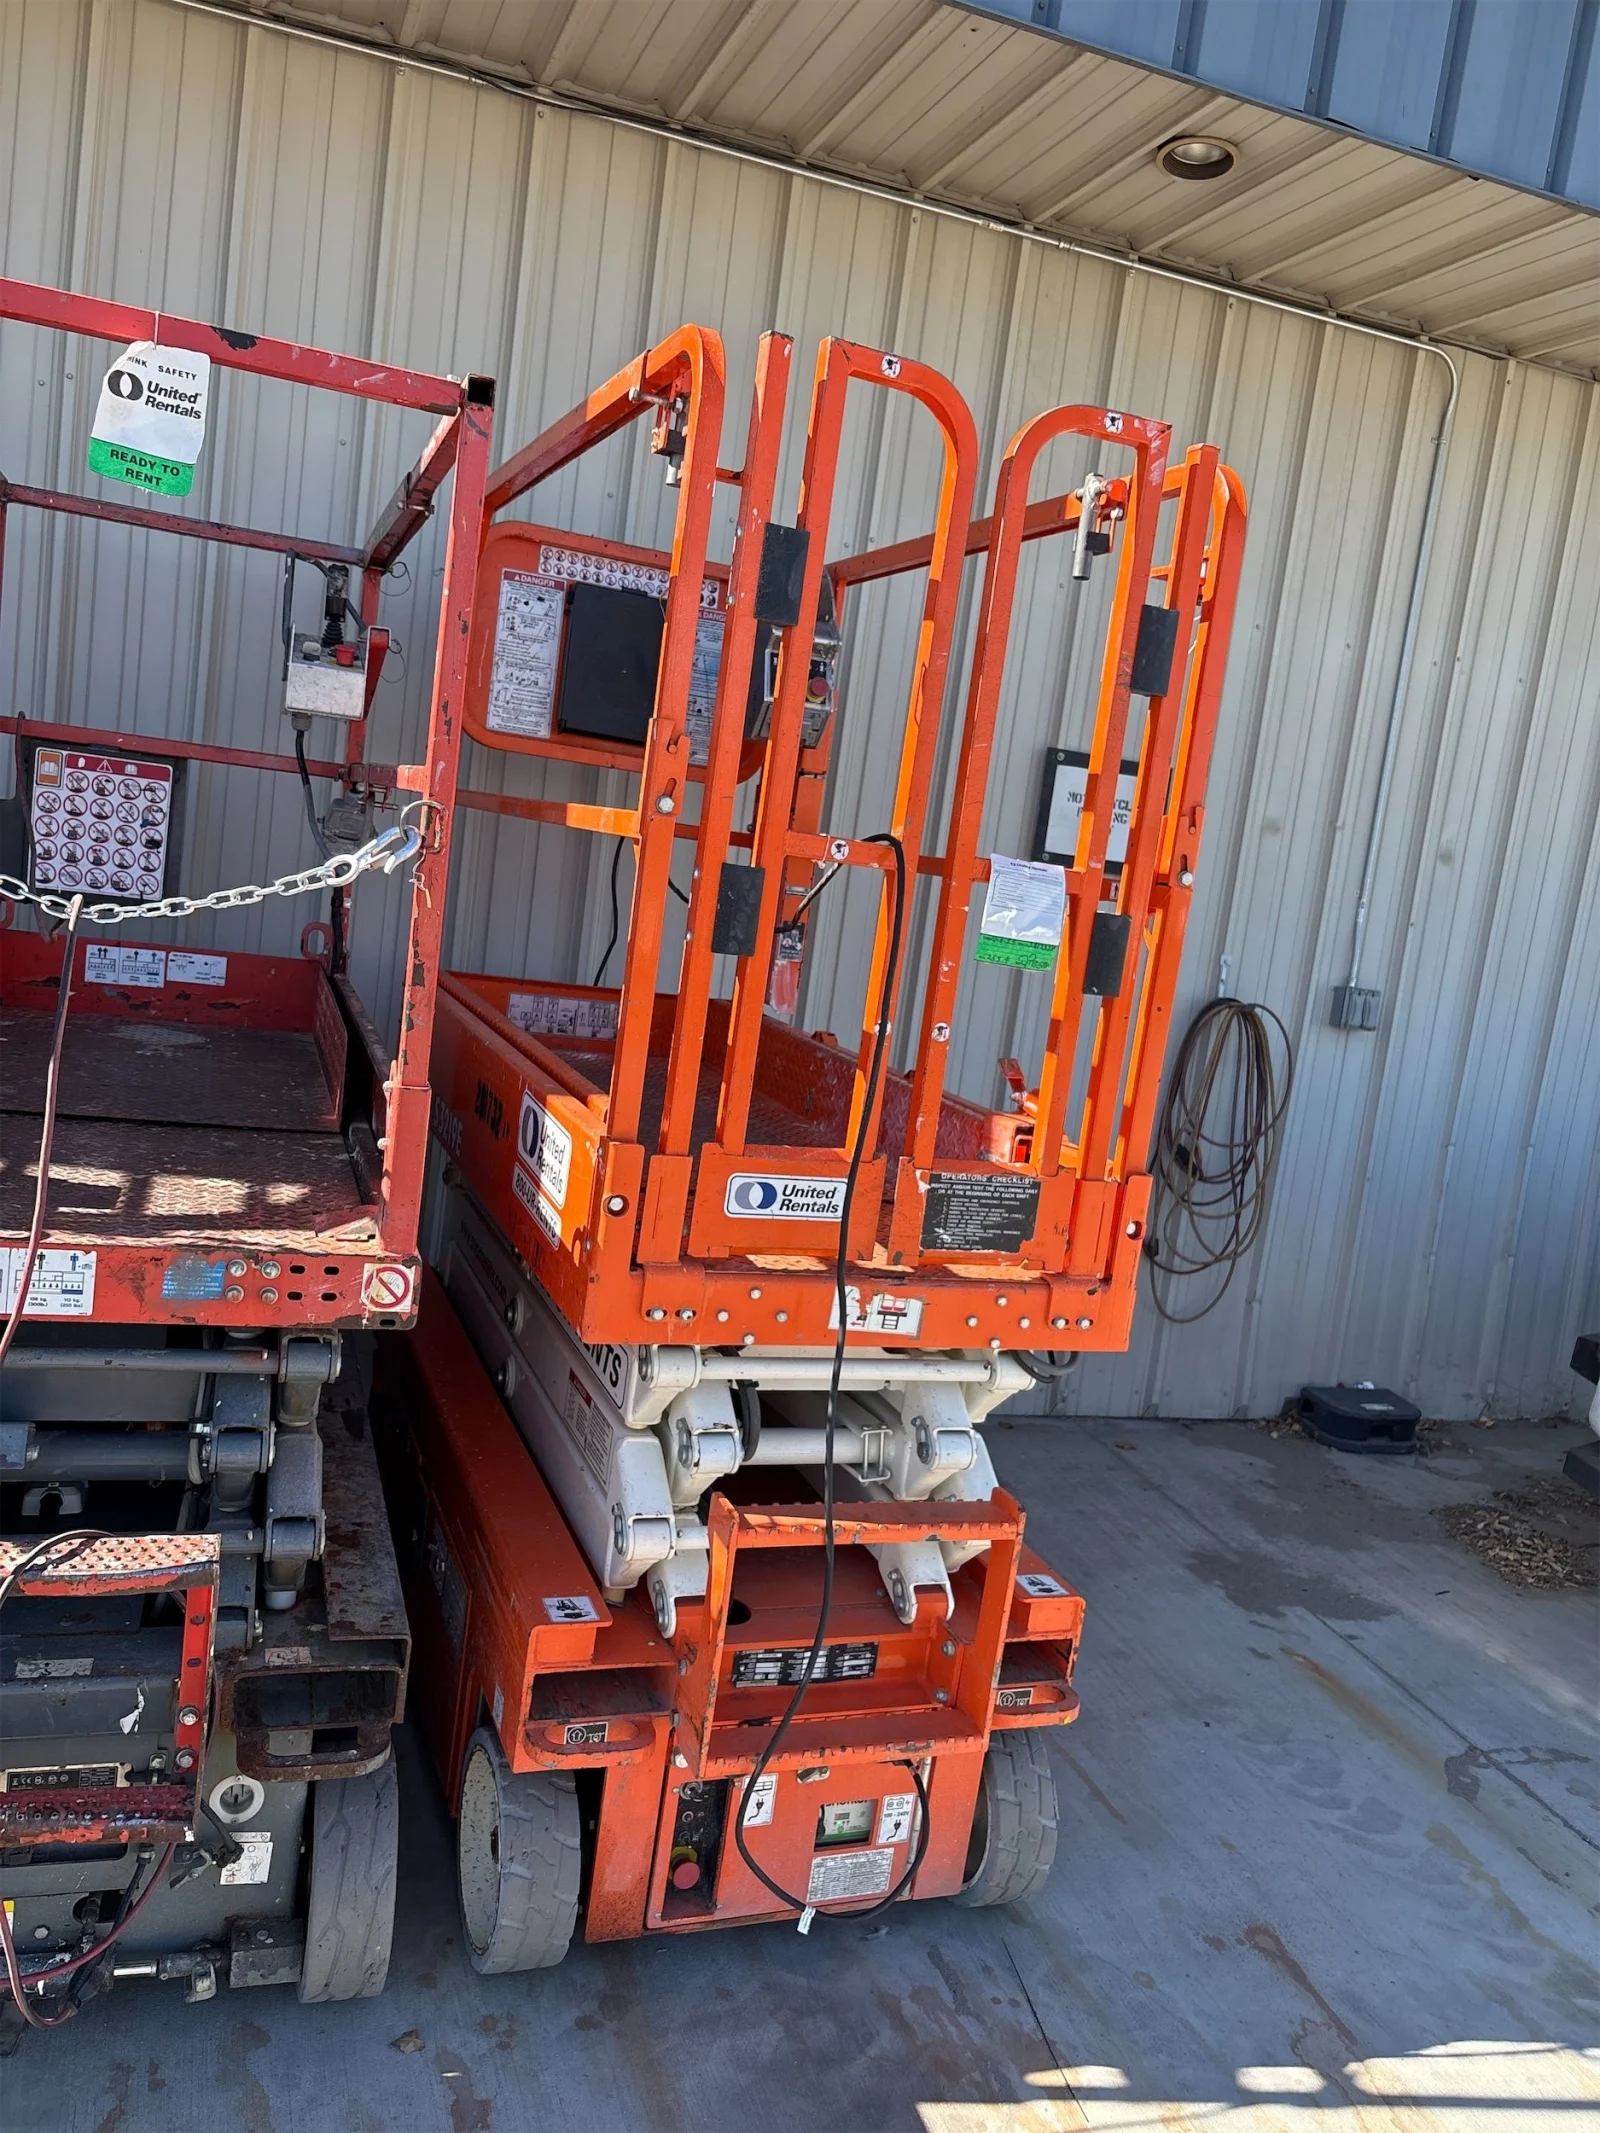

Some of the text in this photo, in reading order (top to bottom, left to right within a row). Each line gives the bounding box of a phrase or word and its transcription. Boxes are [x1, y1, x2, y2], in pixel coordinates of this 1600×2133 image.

[157, 365, 198, 381] SAFETY
[147, 380, 199, 404] United
[145, 396, 202, 420] Rentals
[110, 449, 180, 477] READY TO
[125, 467, 162, 487] RENT
[521, 575, 555, 588] DANGER
[540, 1121, 566, 1166] United
[536, 1149, 564, 1194] Rentals
[992, 1175, 1034, 1185] CHECKLIST
[782, 1184, 837, 1199] United
[779, 1198, 840, 1214] Rentals
[583, 1343, 622, 1388] NTS
